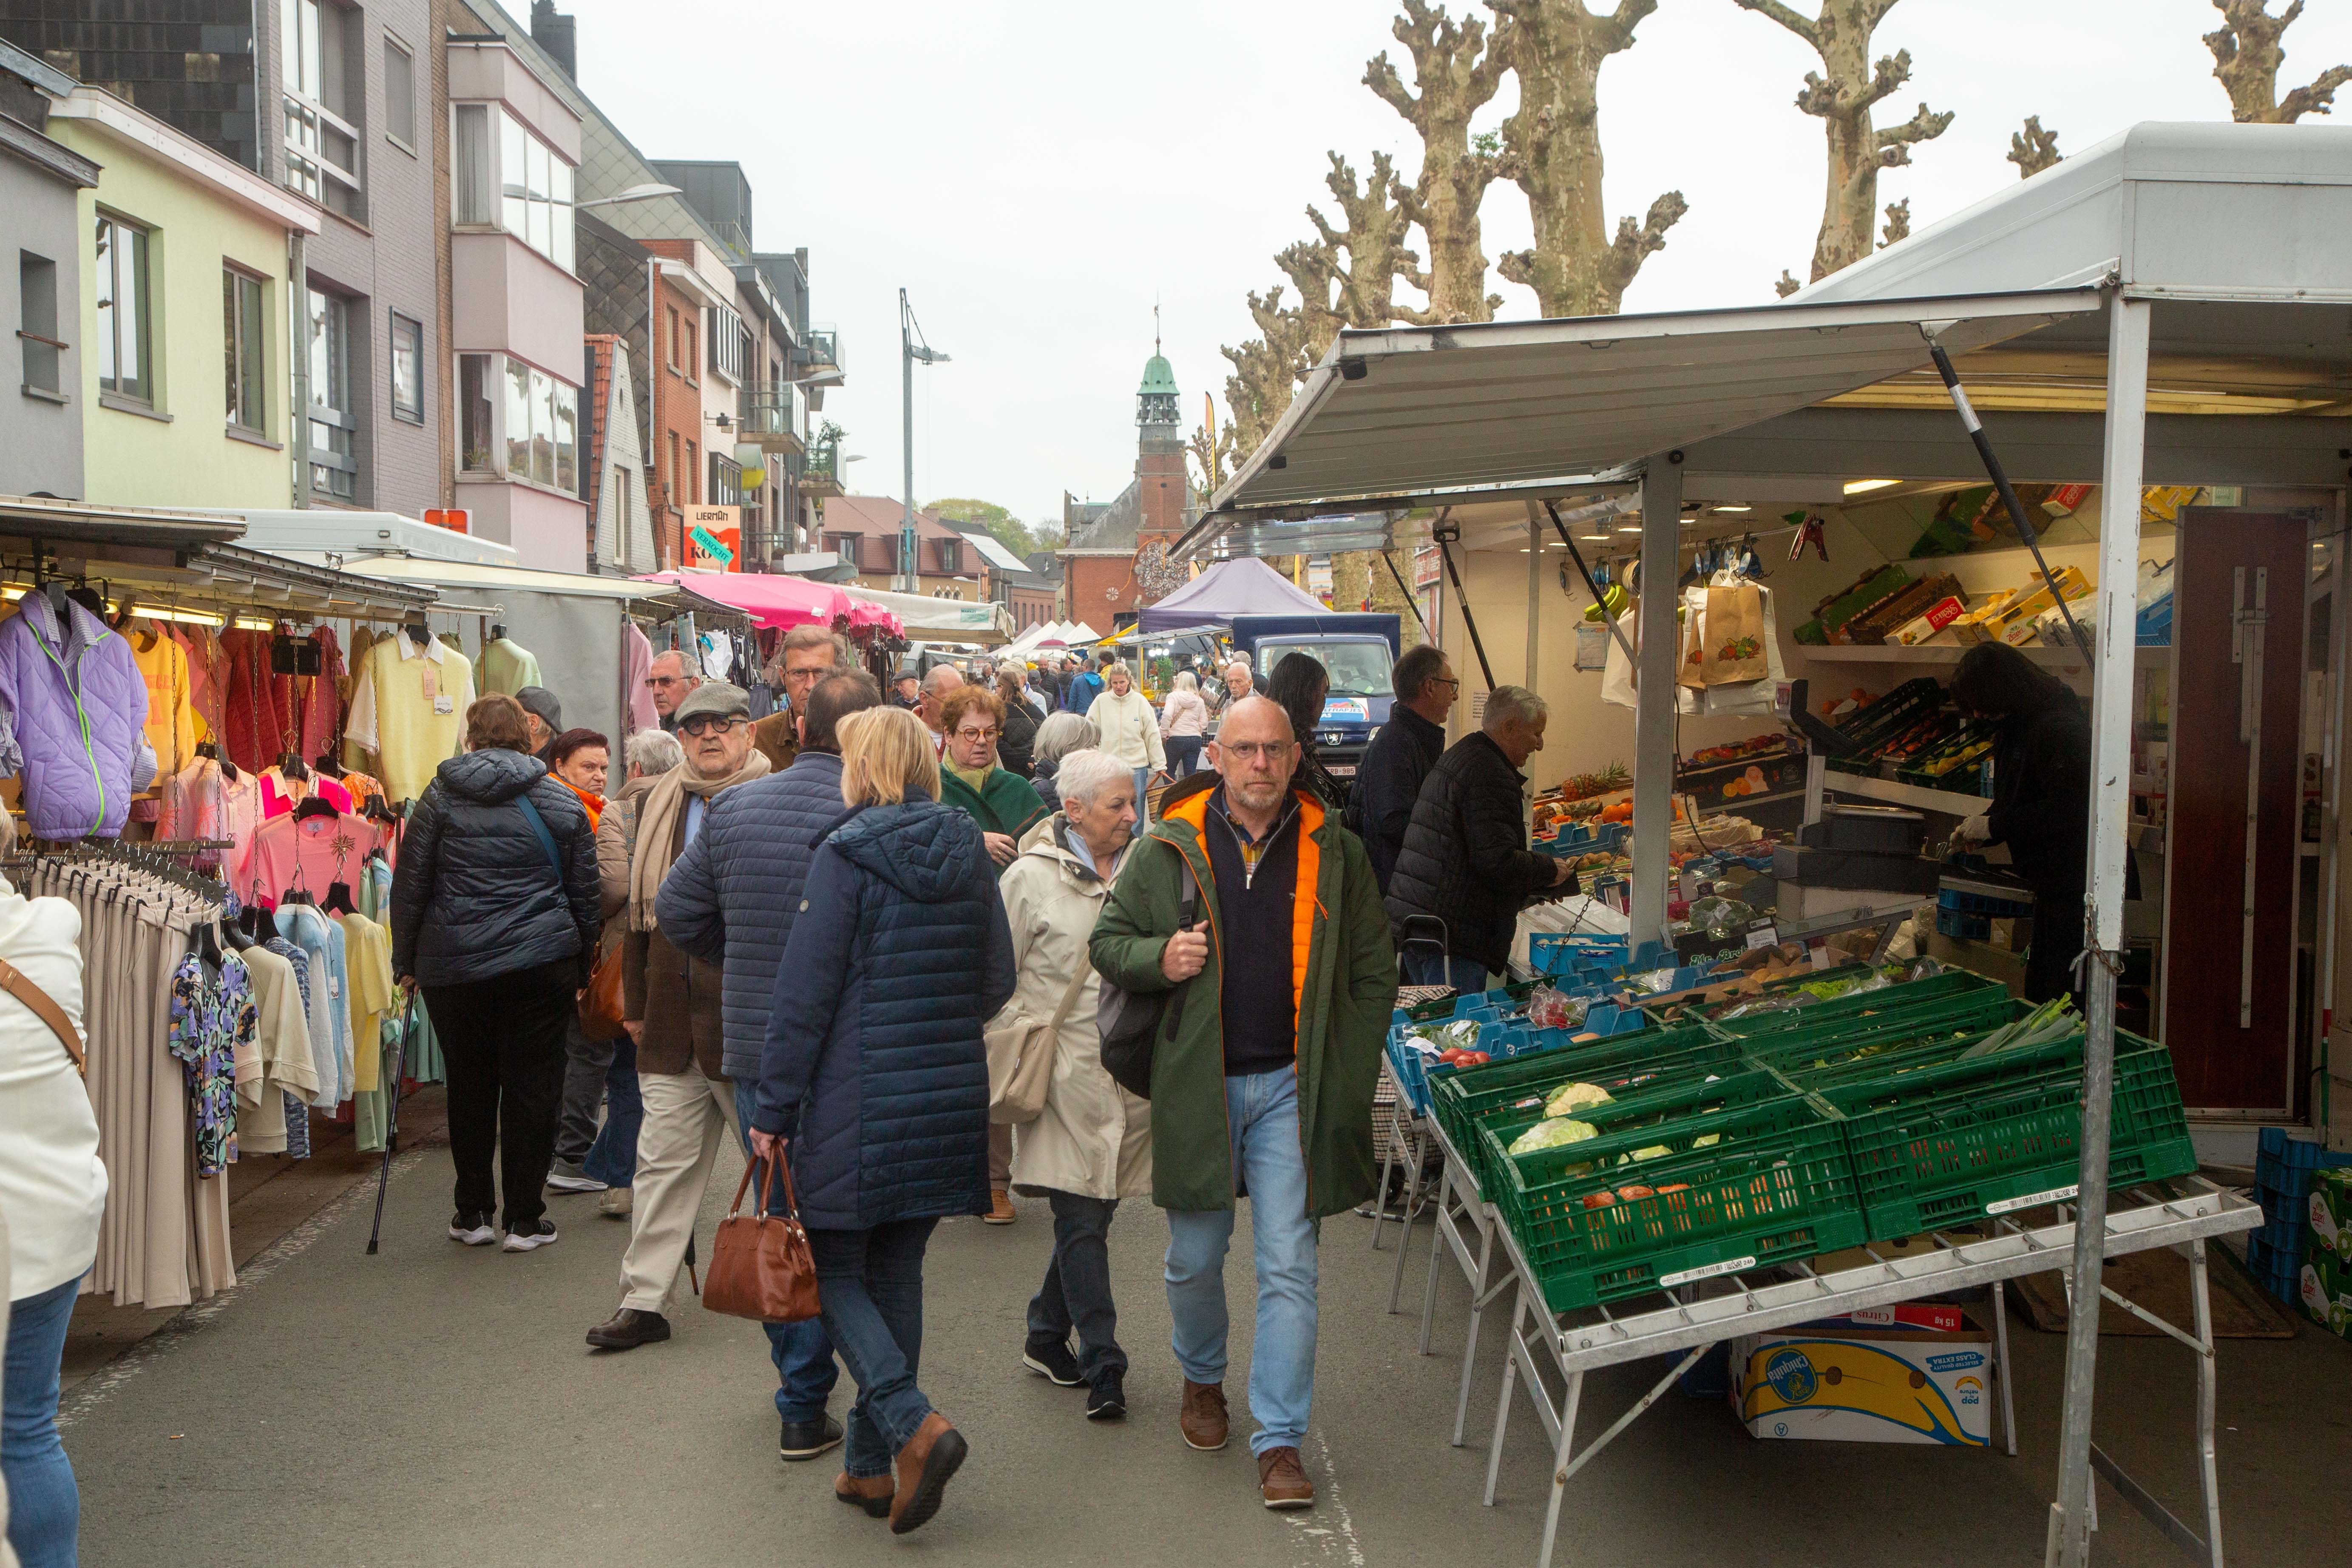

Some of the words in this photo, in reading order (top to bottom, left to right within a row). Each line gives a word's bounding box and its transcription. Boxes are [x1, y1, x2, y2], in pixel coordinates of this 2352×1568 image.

[696, 511, 728, 521] LIERMAN
[696, 531, 729, 560] VERKOCHT
[1857, 1311, 1890, 1322] Citrus
[1935, 1316, 1944, 1326] kg
[1946, 1318, 1955, 1327] 15
[1933, 1356, 1955, 1364] EXTRA
[1956, 1353, 1976, 1362] CLASS
[1767, 1354, 1810, 1382] Chiquita
[1956, 1360, 1979, 1368] SELECTED
[1961, 1395, 1979, 1405] pop
[1778, 1425, 1785, 1435] A
